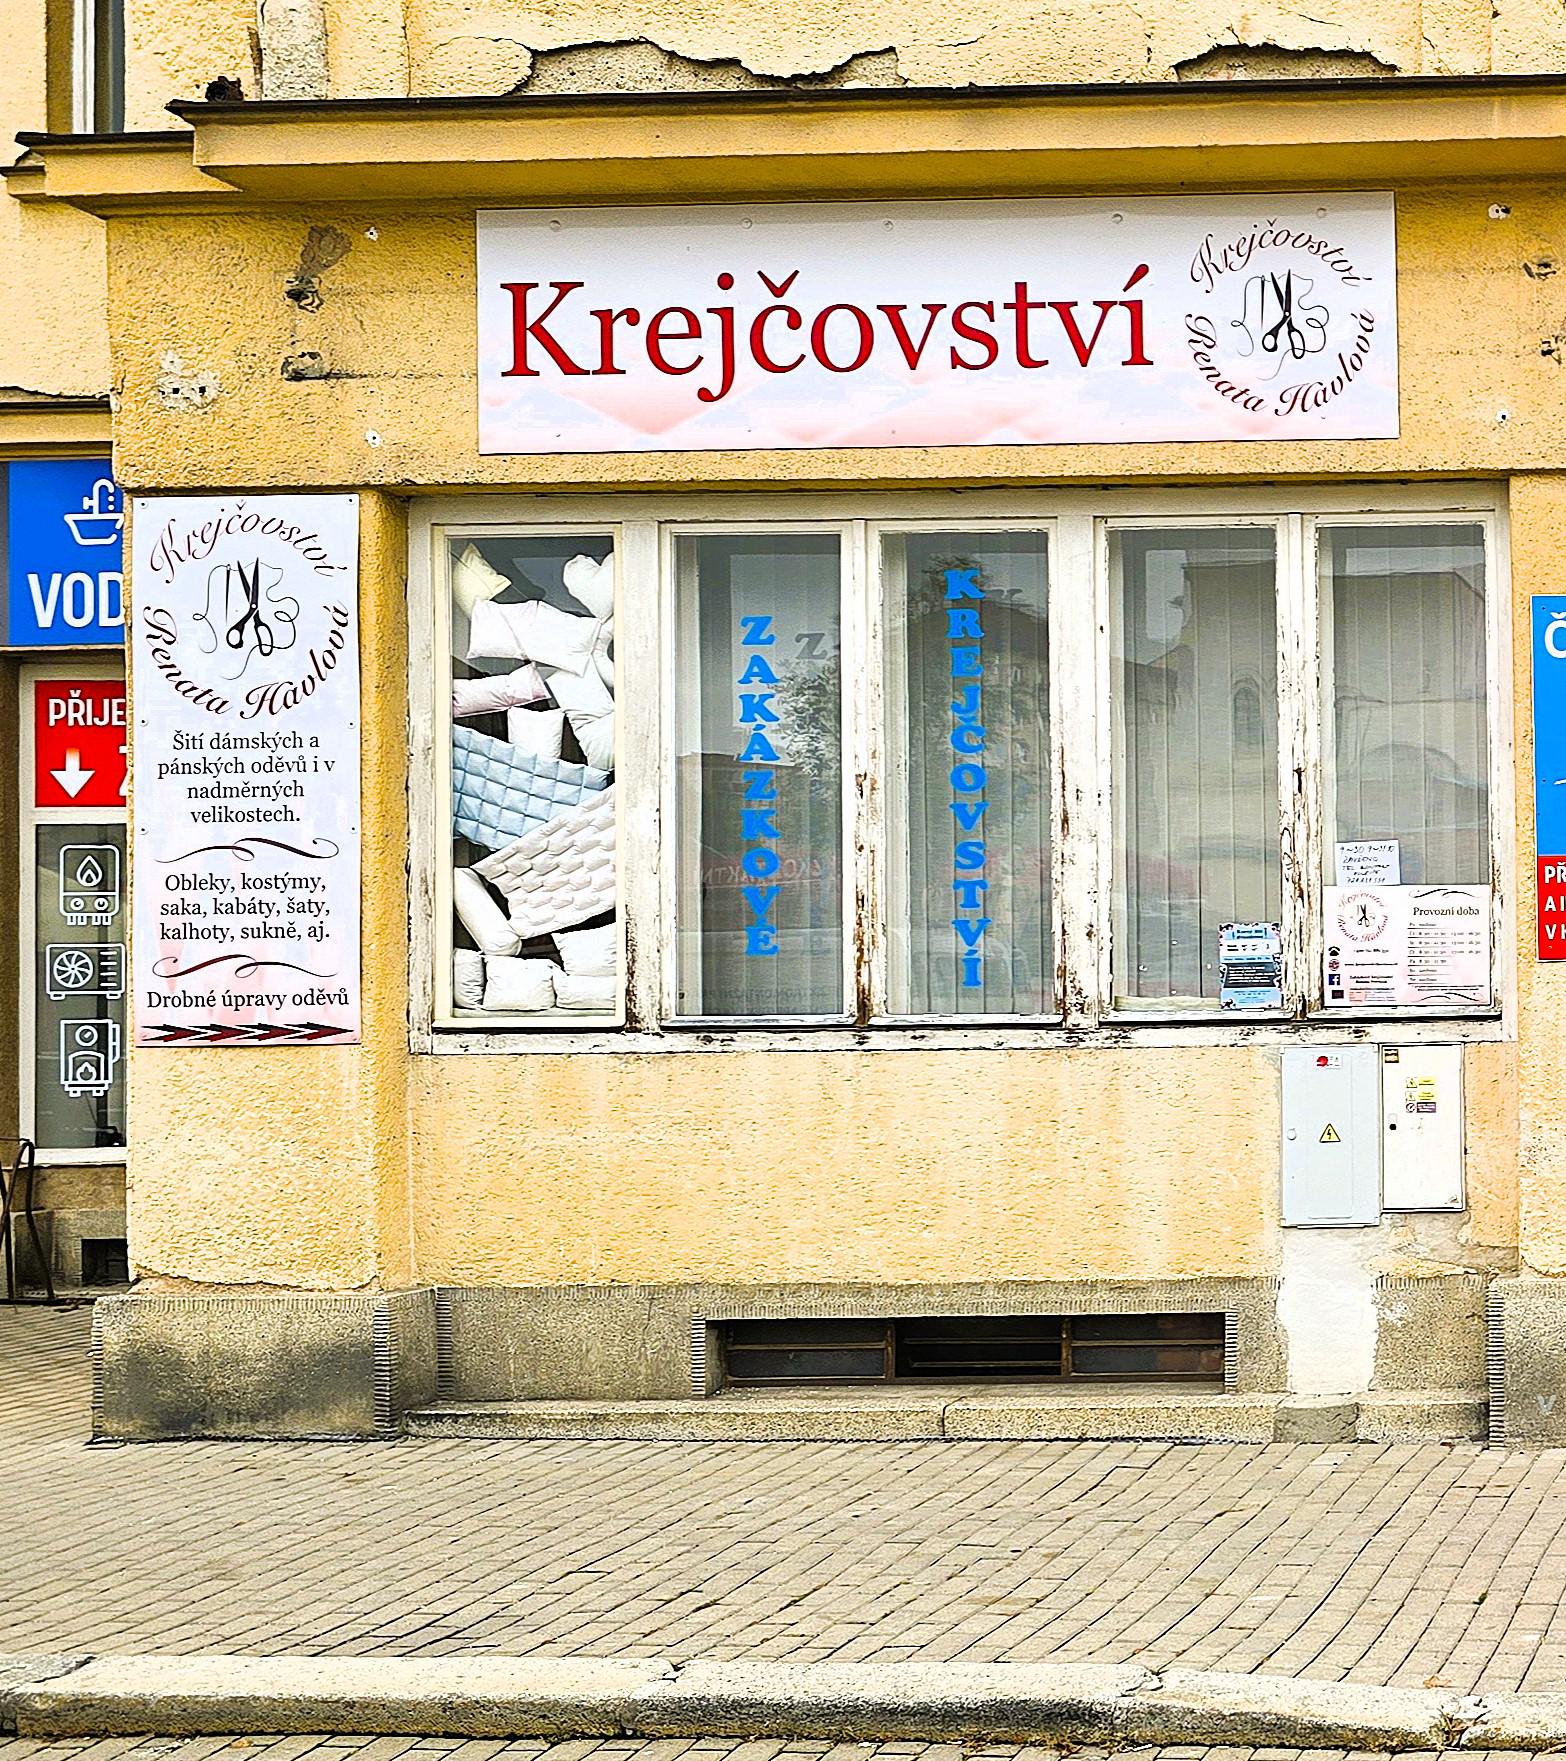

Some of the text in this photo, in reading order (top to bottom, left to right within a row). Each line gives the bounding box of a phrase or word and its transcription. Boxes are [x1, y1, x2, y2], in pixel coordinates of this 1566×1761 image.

[1190, 218, 1373, 293] Krejčovství
[498, 263, 1154, 403] Krejčovství
[1185, 308, 1375, 416] Renata Havlová
[150, 499, 348, 584] Krejčovství
[143, 601, 349, 719] Renata Havlová
[172, 730, 320, 752] Šití dámských a
[157, 755, 336, 779] pánských oděvů i v
[944, 568, 992, 987] KREJČOVSTVÍ
[187, 780, 305, 801] nadměrných
[737, 615, 781, 957] ZAKÁZKOVÉ
[191, 805, 301, 823] velikostech.
[165, 872, 327, 894] Obleky, kostýmy,
[160, 897, 331, 918] saka, kabáty, šaty,
[1413, 906, 1480, 916] Provozní doba
[1544, 895, 1556, 912] A
[160, 921, 330, 943] kalhoty, sukně, aj.
[1545, 923, 1557, 939] V
[147, 987, 349, 1011] Drobné úpravy oděvů
